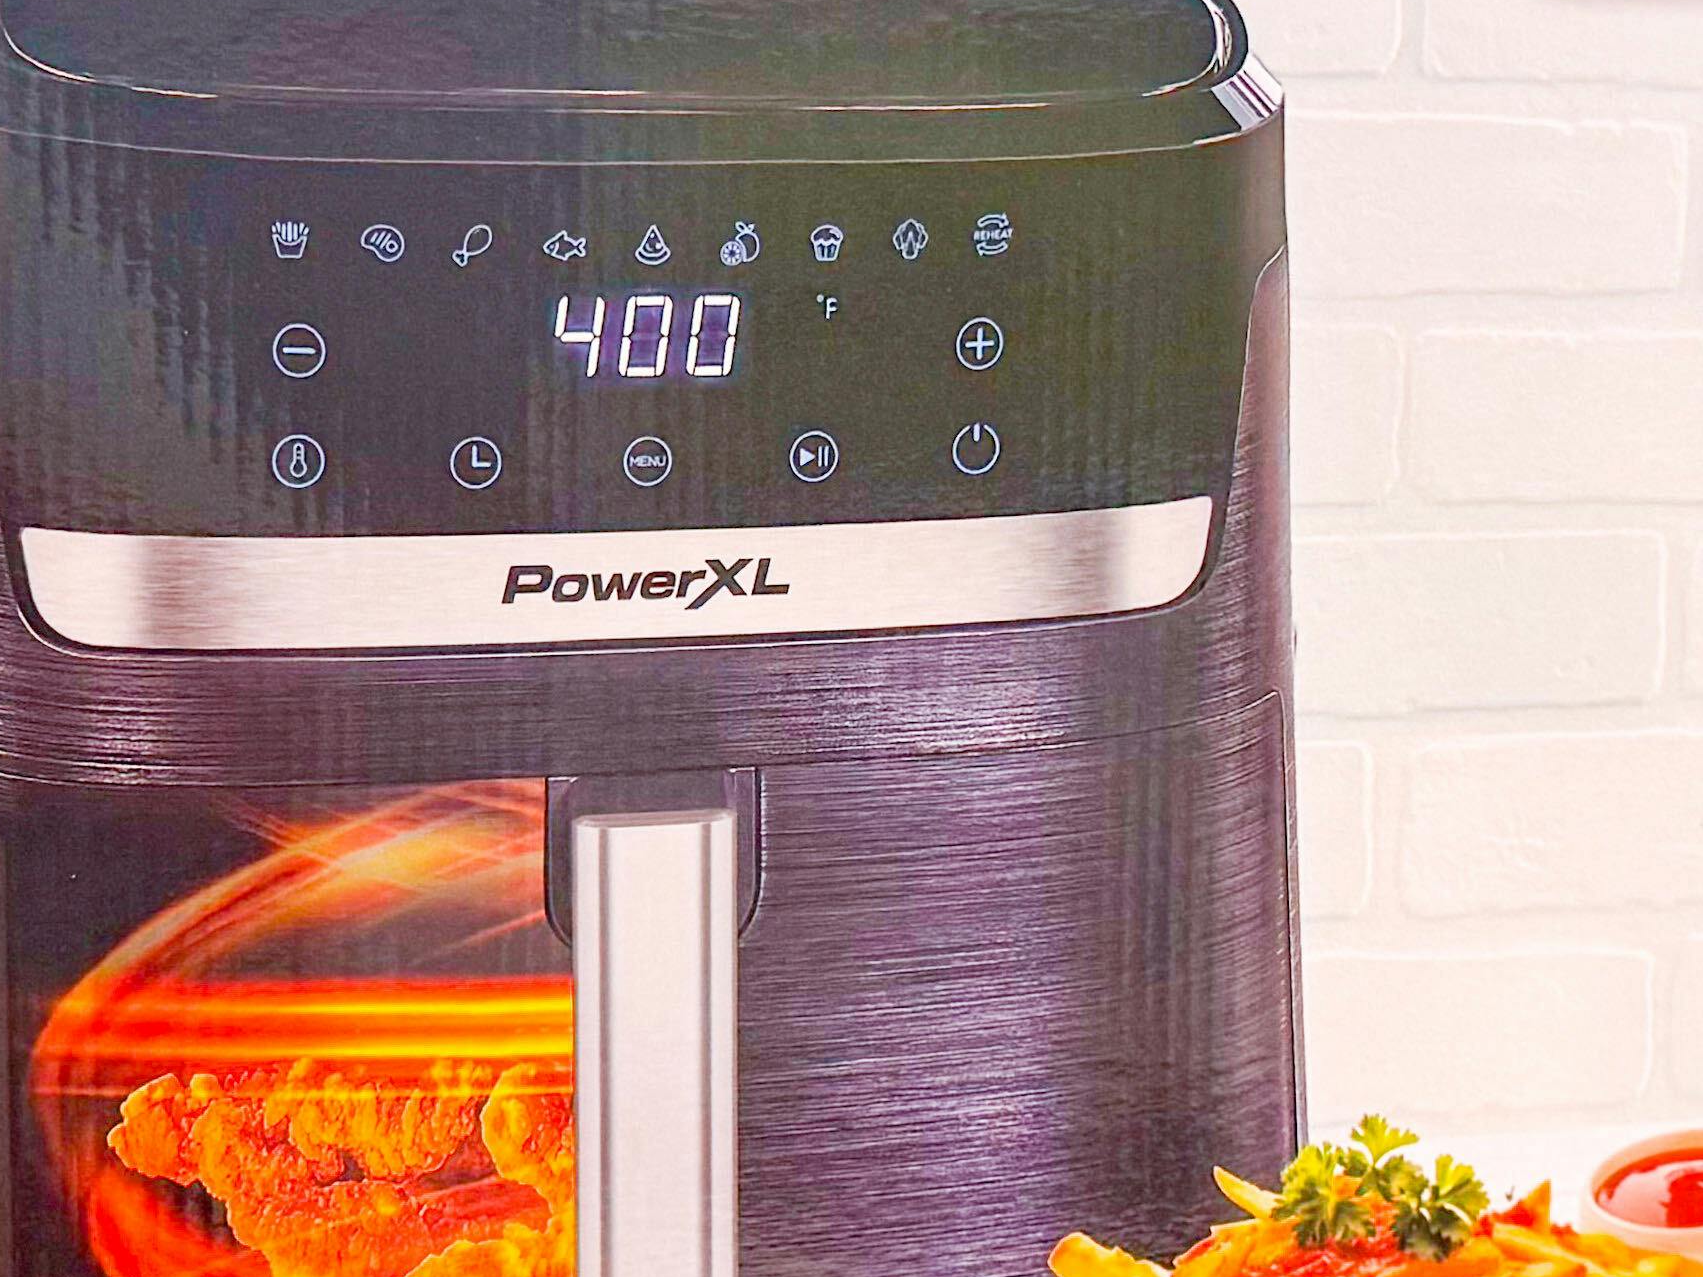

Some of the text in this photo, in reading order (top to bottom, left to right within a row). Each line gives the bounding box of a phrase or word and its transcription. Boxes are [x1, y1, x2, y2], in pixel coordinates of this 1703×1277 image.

[973, 228, 1013, 241] REHEAT
[554, 293, 742, 378] 400
[629, 455, 666, 468] MENU
[501, 557, 790, 610] PowerXL
